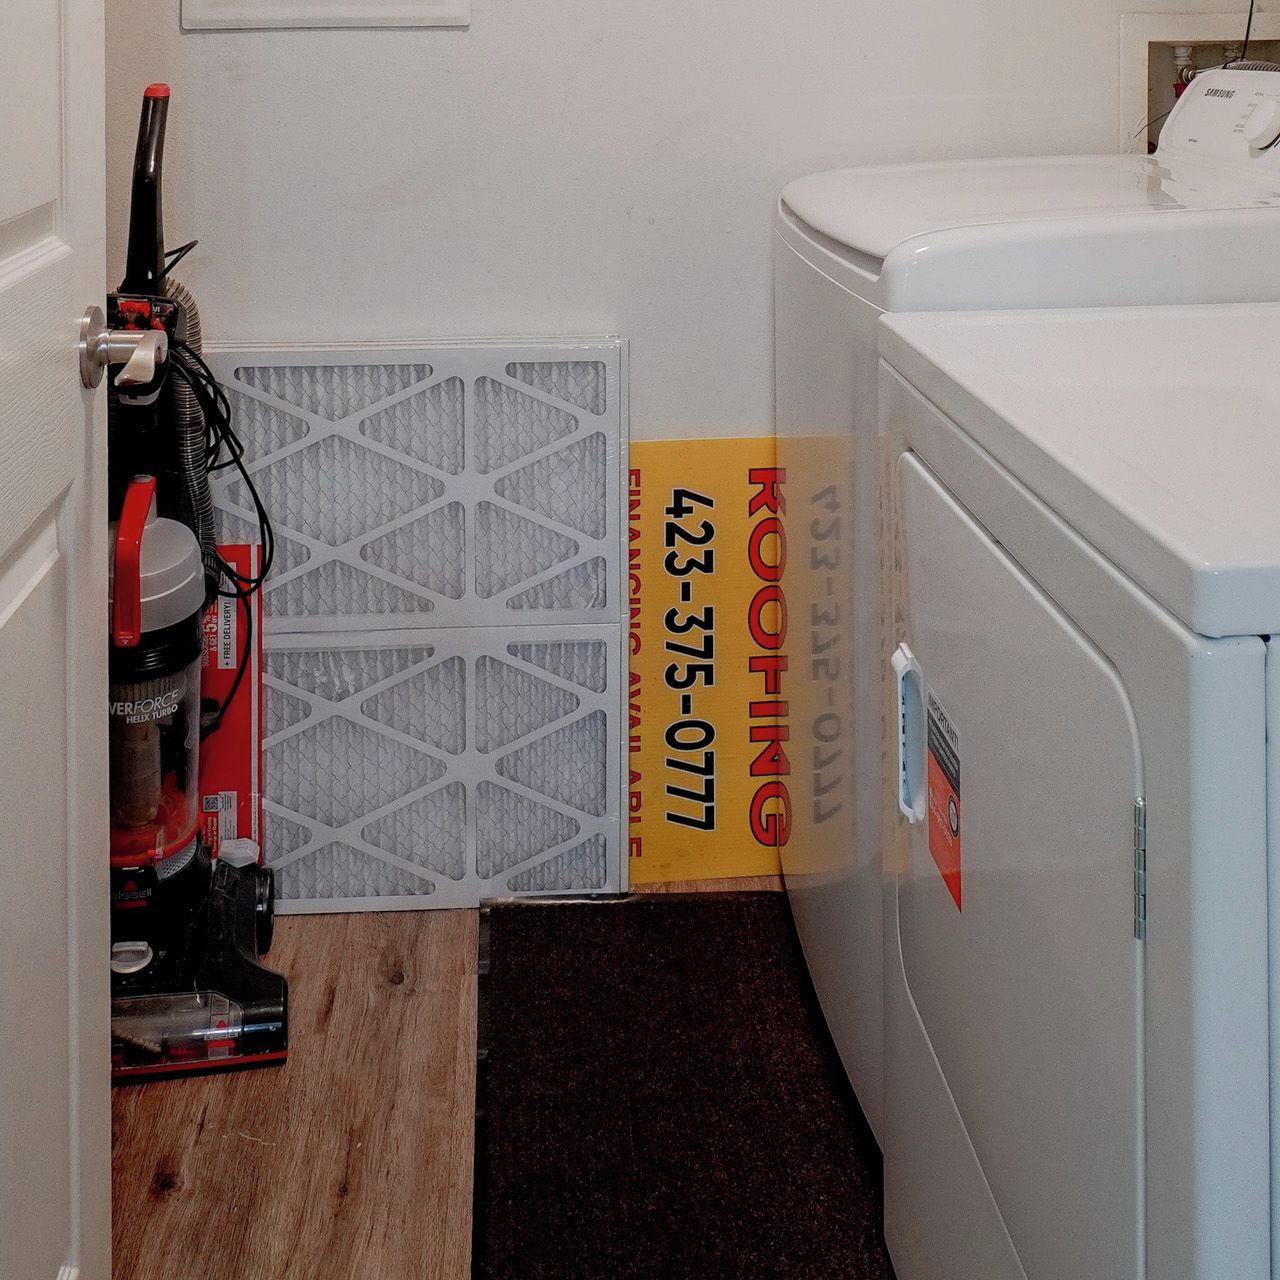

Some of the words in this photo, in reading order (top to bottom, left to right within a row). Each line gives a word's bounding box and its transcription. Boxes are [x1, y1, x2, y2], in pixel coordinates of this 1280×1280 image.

[1204, 87, 1237, 99] SAMSUNG
[223, 602, 231, 640] DELIVERY!
[223, 641, 231, 660] FREE
[663, 487, 716, 832] 423-375-0777
[126, 713, 150, 725] HELIX
[152, 704, 178, 720] TURBO
